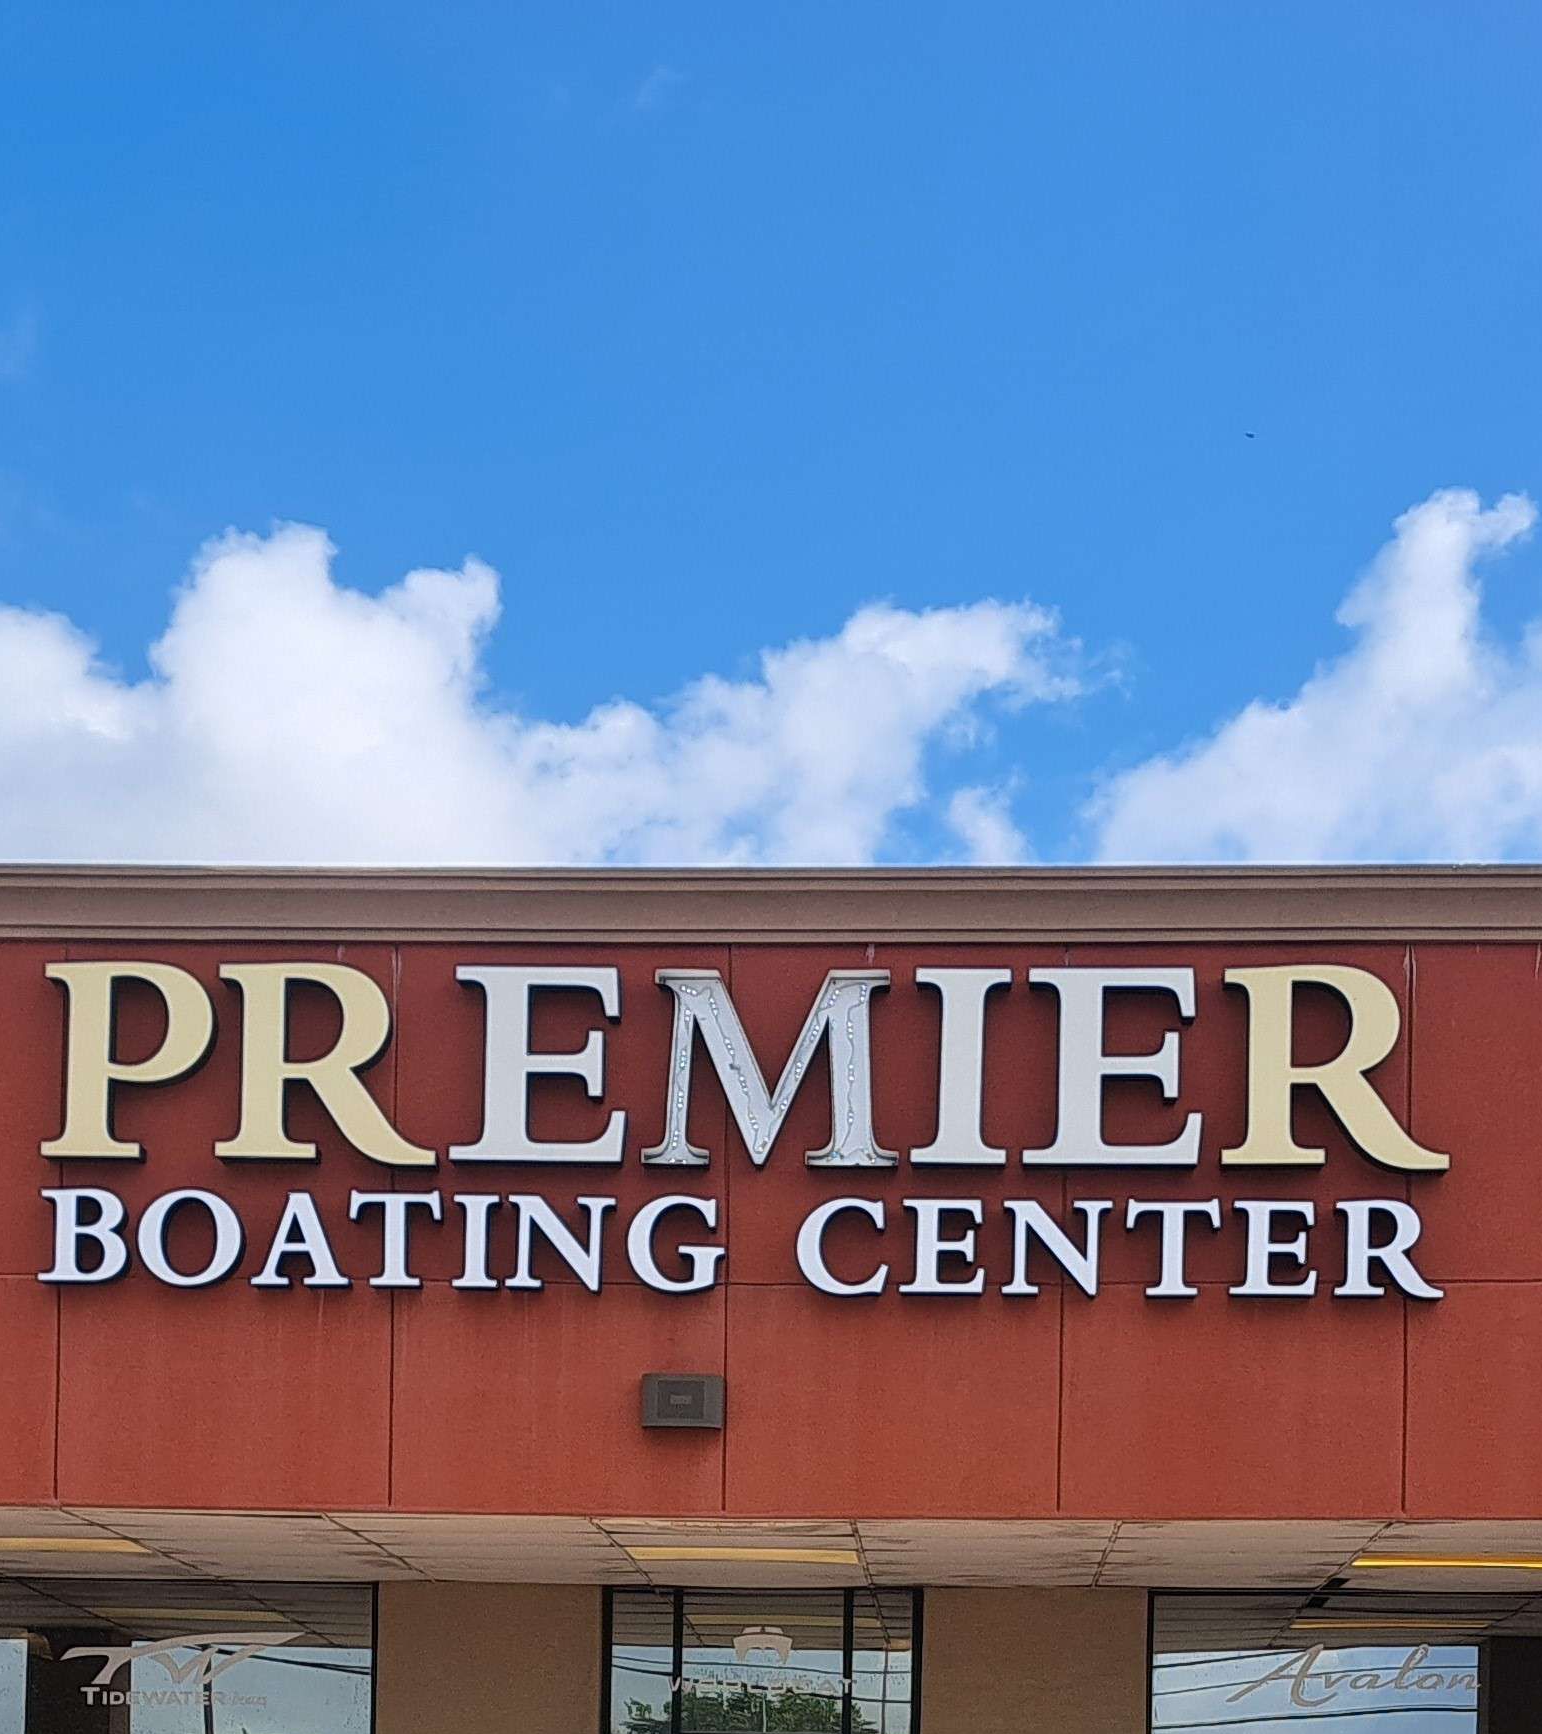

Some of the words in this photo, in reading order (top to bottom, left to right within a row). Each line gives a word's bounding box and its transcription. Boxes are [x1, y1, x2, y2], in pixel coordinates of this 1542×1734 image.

[40, 960, 1451, 1169] PREMIER
[38, 1187, 728, 1292] BOATING
[796, 1198, 1445, 1299] CENTER
[80, 1686, 225, 1706] TIDEWATER
[1226, 1643, 1481, 1708] Avalon
